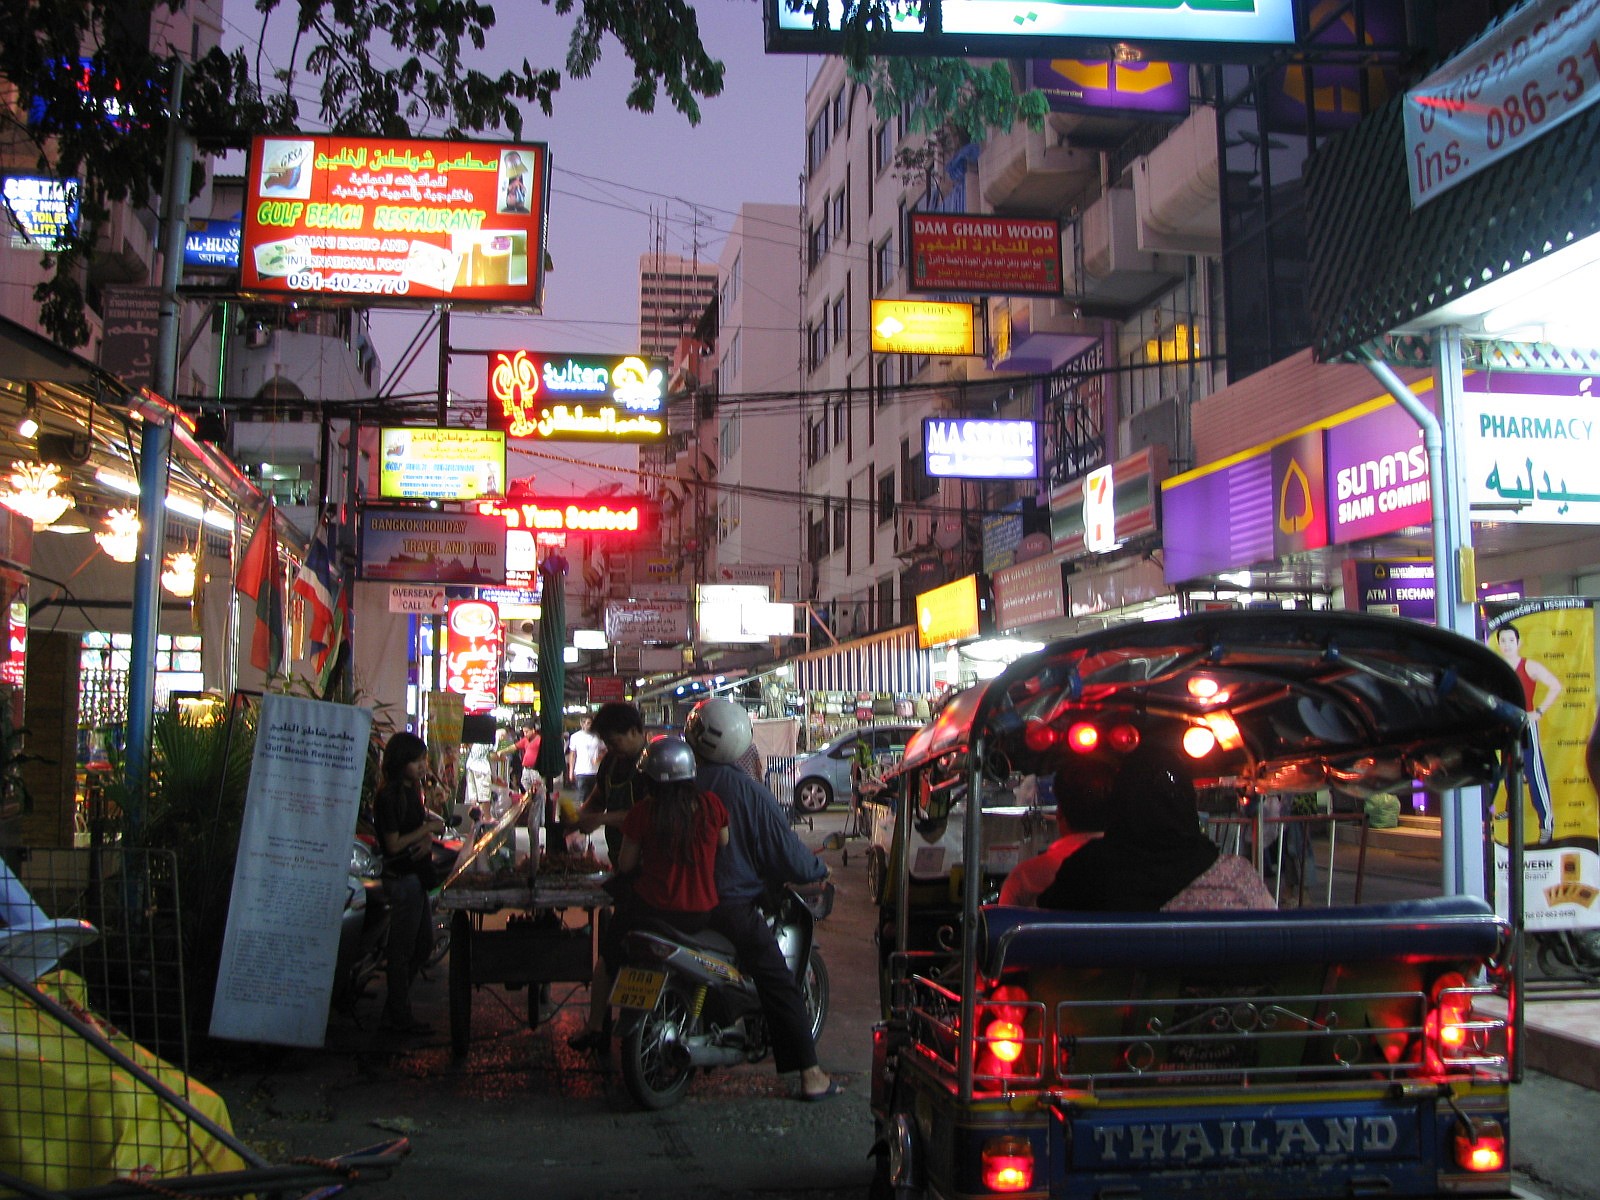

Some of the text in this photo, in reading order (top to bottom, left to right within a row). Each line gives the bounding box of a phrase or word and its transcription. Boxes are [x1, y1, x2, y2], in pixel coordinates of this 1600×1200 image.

[258, 201, 486, 233] GULF BEACH RESTAURANT
[914, 220, 1054, 239] DAM GHARU WOOD
[185, 236, 240, 253] AL-HUSS
[294, 235, 409, 252] OMANI EXOTIC AND
[285, 254, 375, 271] INTERNATIONAL
[287, 272, 409, 295] 081-4025770
[1479, 412, 1593, 441] PHARMACY
[927, 421, 1034, 457] MASSAGE
[1338, 495, 1375, 525] SIAM
[371, 518, 467, 534] BANGKOK HOLIDAY
[402, 539, 498, 556] TRAVEL AND TOUR
[392, 588, 434, 598] OVERSEAS
[1366, 587, 1435, 601] ATM EXCHAN
[402, 600, 422, 610] CALL
[1497, 859, 1554, 870] VWERK
[1093, 1115, 1398, 1160] THAILAND
